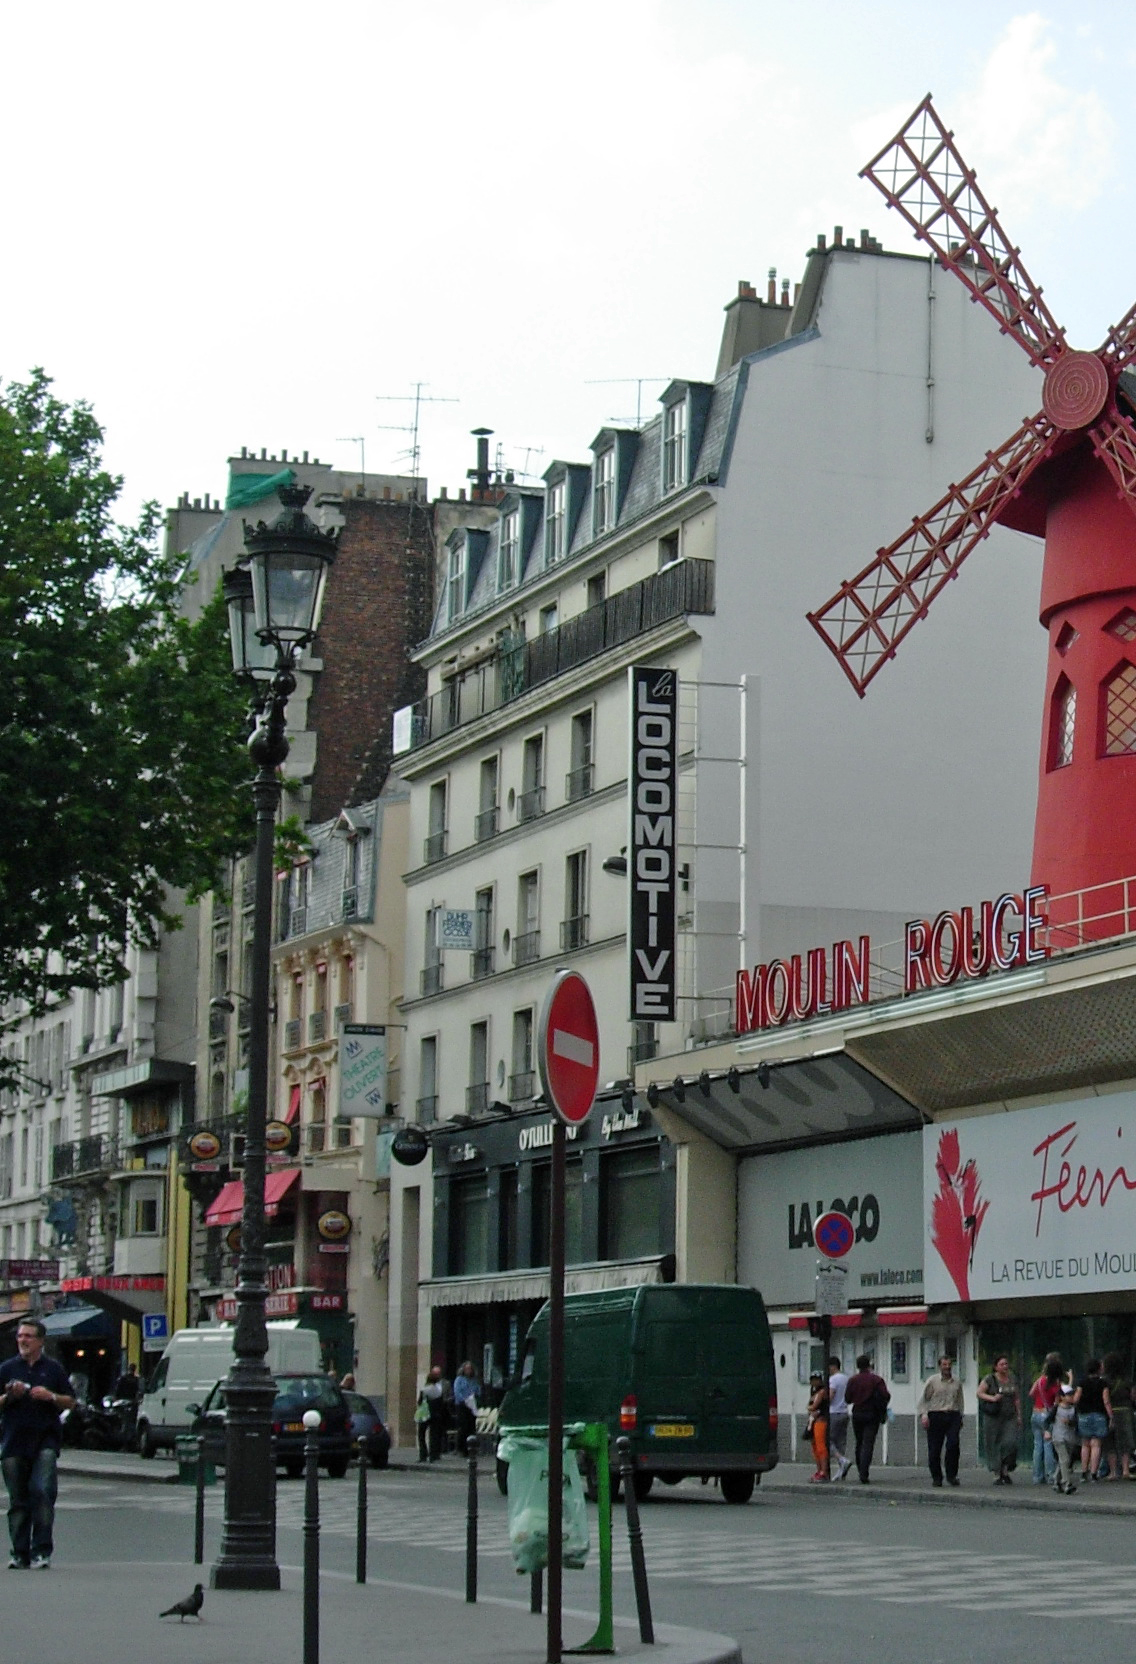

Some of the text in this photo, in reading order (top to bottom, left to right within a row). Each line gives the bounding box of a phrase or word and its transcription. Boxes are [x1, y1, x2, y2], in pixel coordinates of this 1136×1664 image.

[635, 681, 673, 1014] LOCOMOTIVE
[736, 884, 1050, 1033] MOULIN ROUGE
[313, 1296, 341, 1307] BAR
